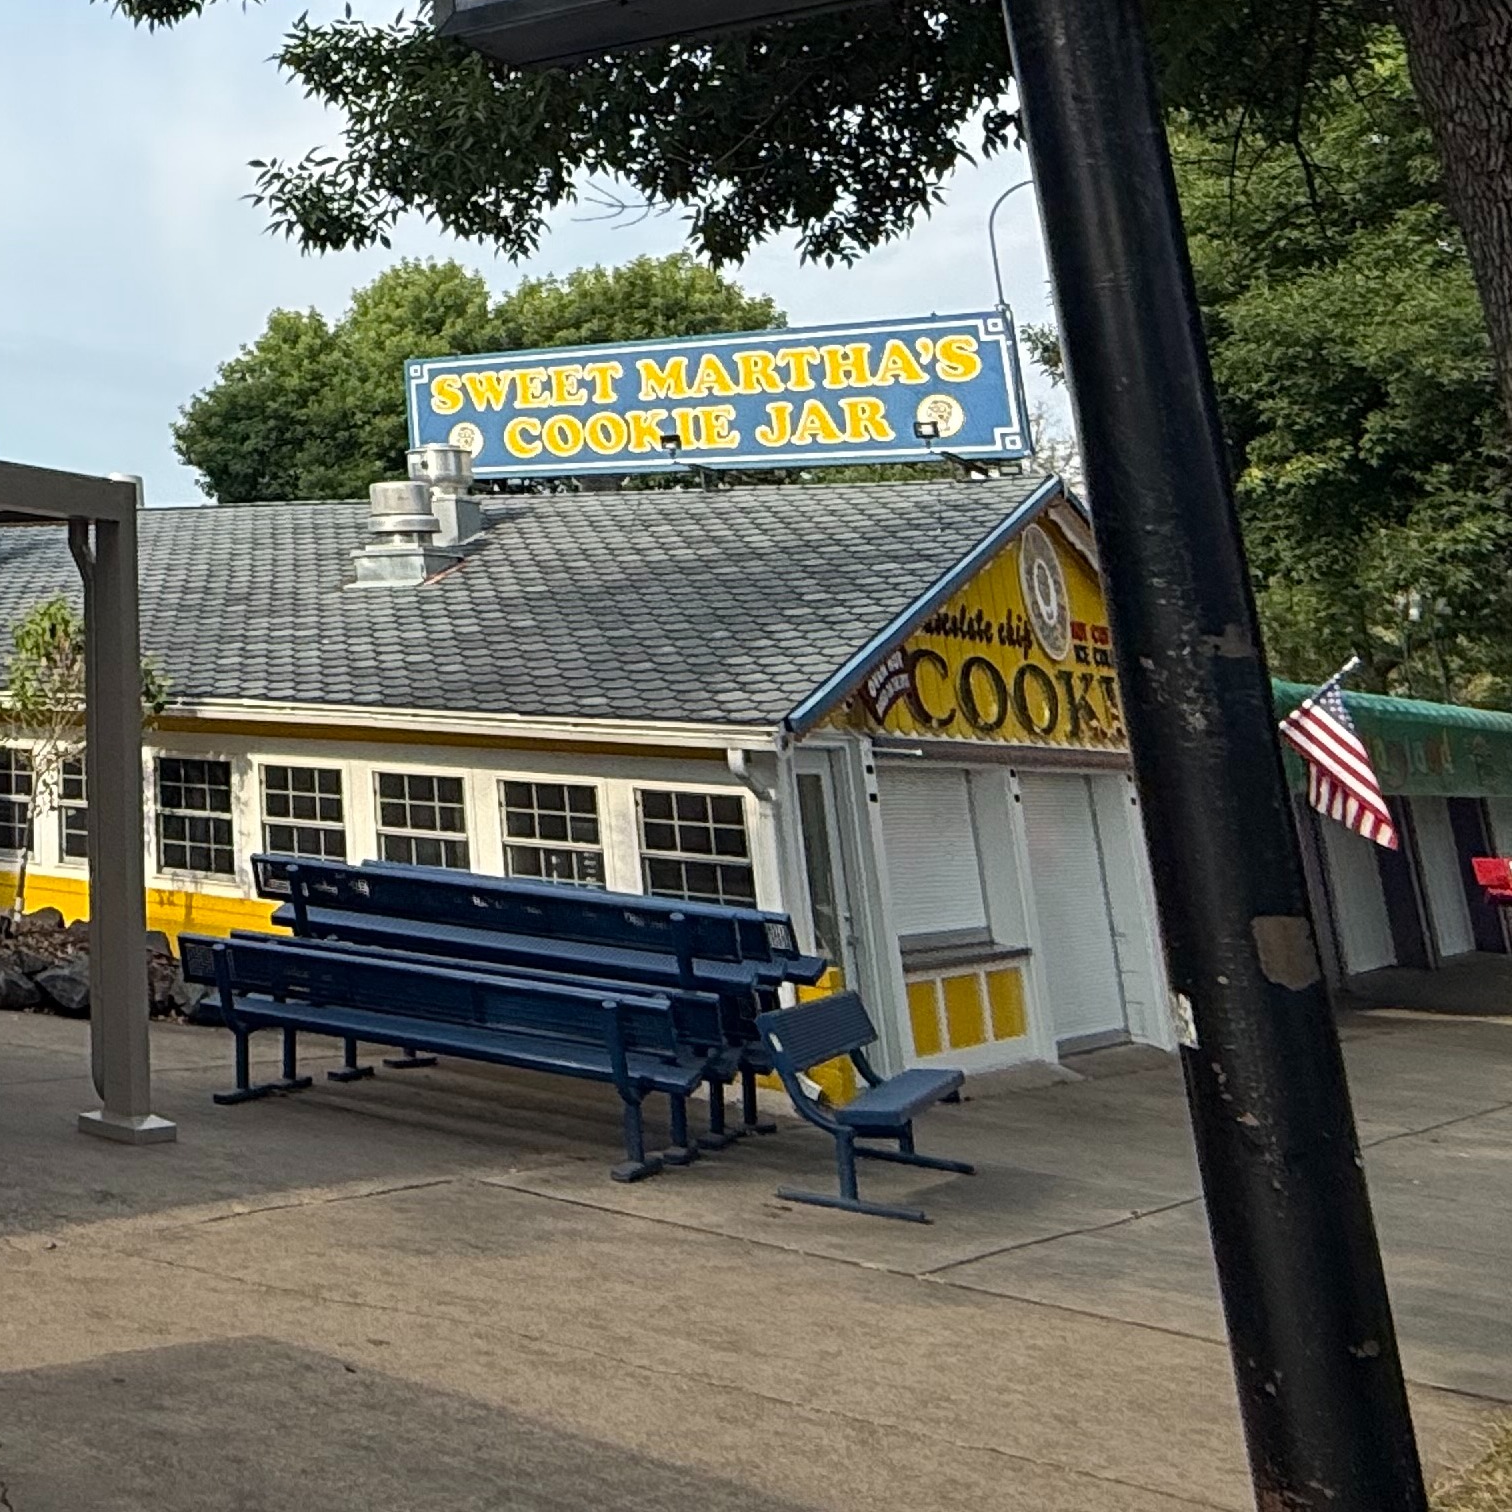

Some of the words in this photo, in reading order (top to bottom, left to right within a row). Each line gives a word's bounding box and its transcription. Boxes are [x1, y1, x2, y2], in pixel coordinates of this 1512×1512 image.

[430, 361, 624, 415] SWEET
[637, 337, 982, 399] MARTHA'S
[502, 405, 736, 459] COOKIE
[754, 394, 896, 450] JAR
[997, 607, 1033, 661] chip
[905, 648, 1127, 740] COOKI
